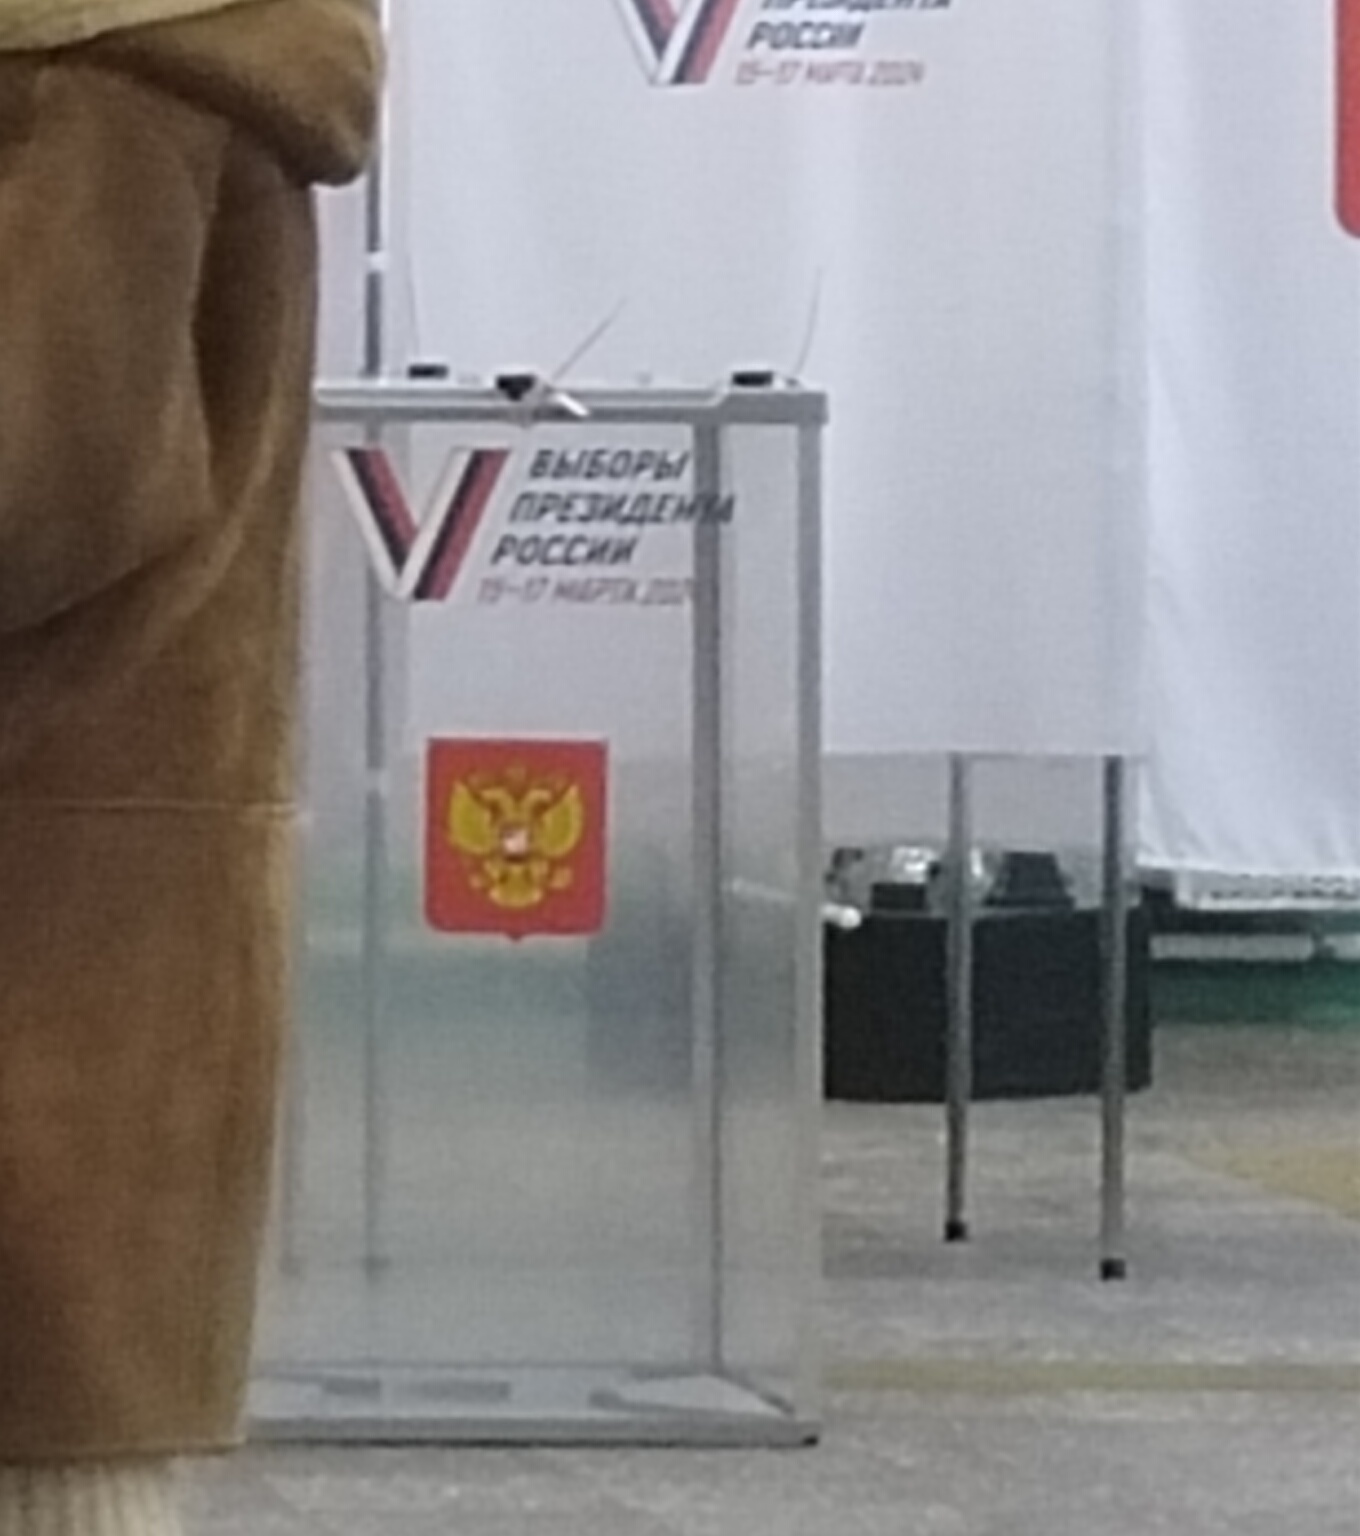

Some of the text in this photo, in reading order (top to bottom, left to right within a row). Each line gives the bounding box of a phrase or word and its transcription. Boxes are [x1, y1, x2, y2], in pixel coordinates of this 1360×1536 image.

[746, 21, 865, 50] РОССИИ
[528, 449, 691, 480] ВЫБОРЫ
[490, 534, 638, 565] РОССИИ
